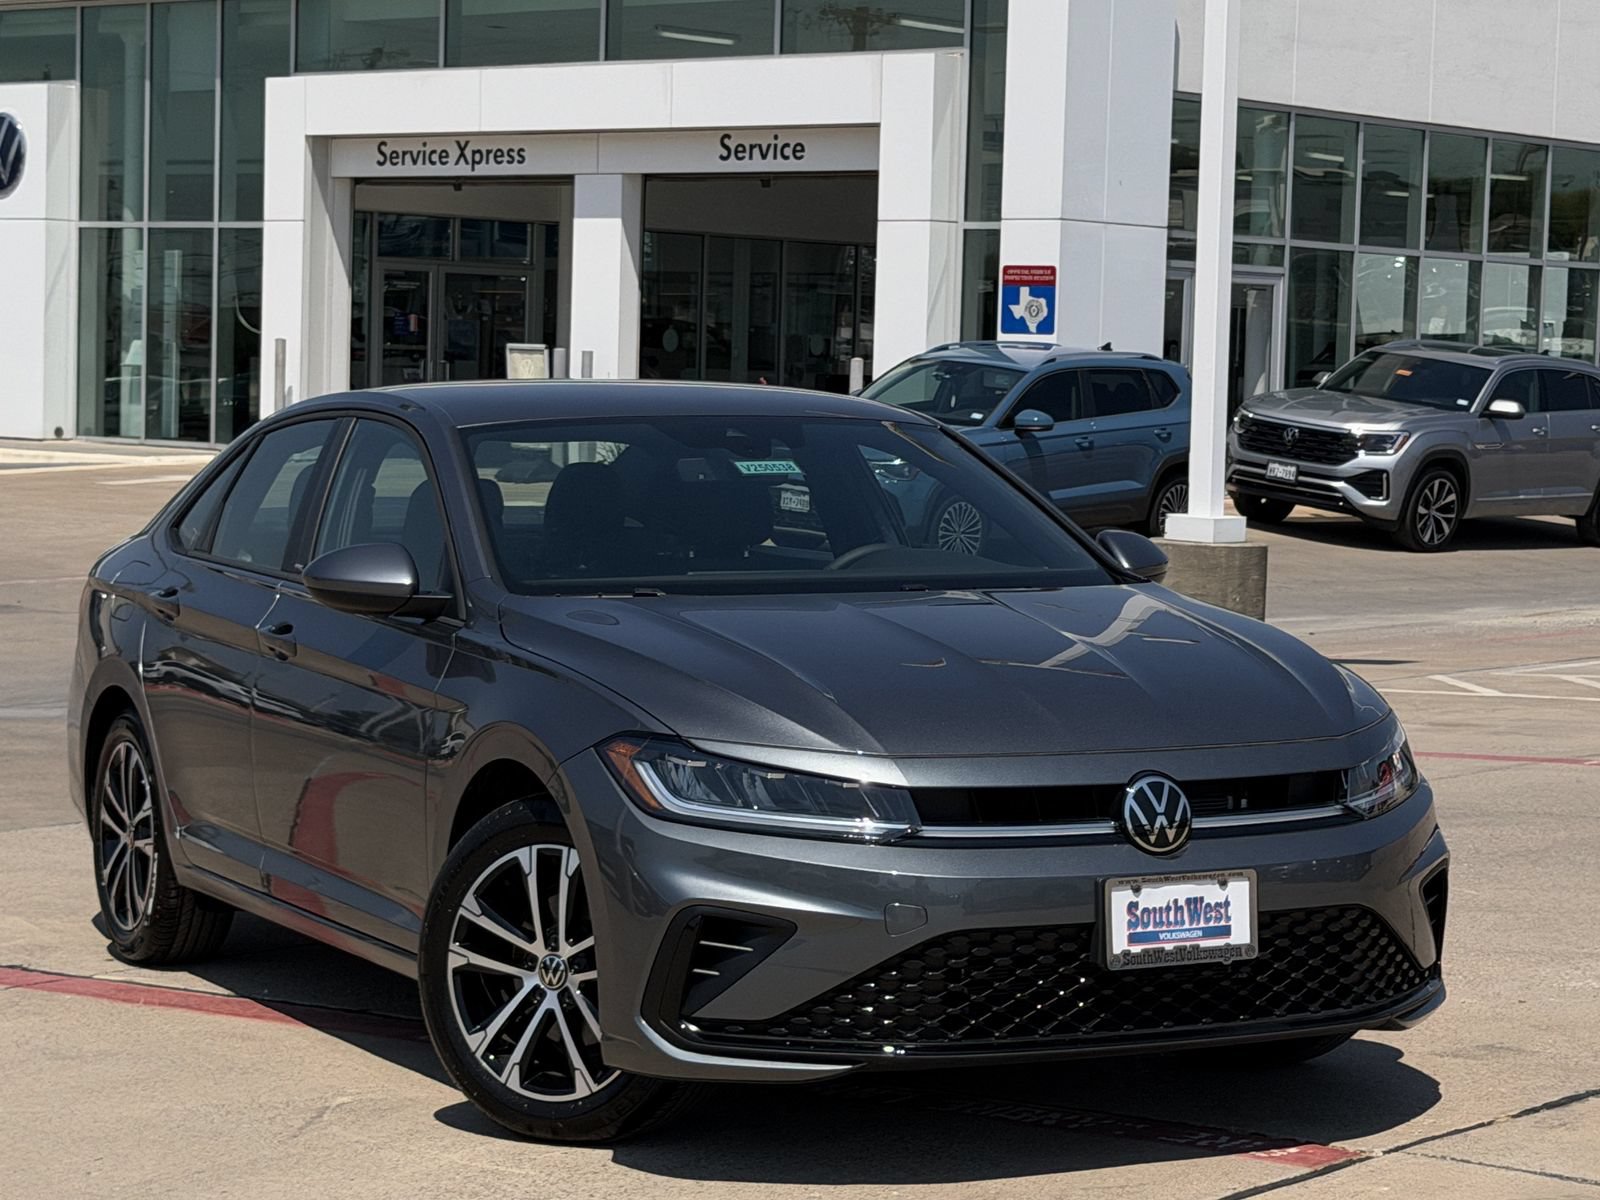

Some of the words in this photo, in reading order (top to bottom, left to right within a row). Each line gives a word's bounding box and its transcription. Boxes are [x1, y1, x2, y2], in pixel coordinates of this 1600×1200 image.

[376, 140, 450, 167] Service
[454, 140, 526, 172] Xpress
[719, 133, 806, 162] Service
[1127, 894, 1232, 931] SouthWest
[1158, 929, 1203, 941] VOLKSWAGEN
